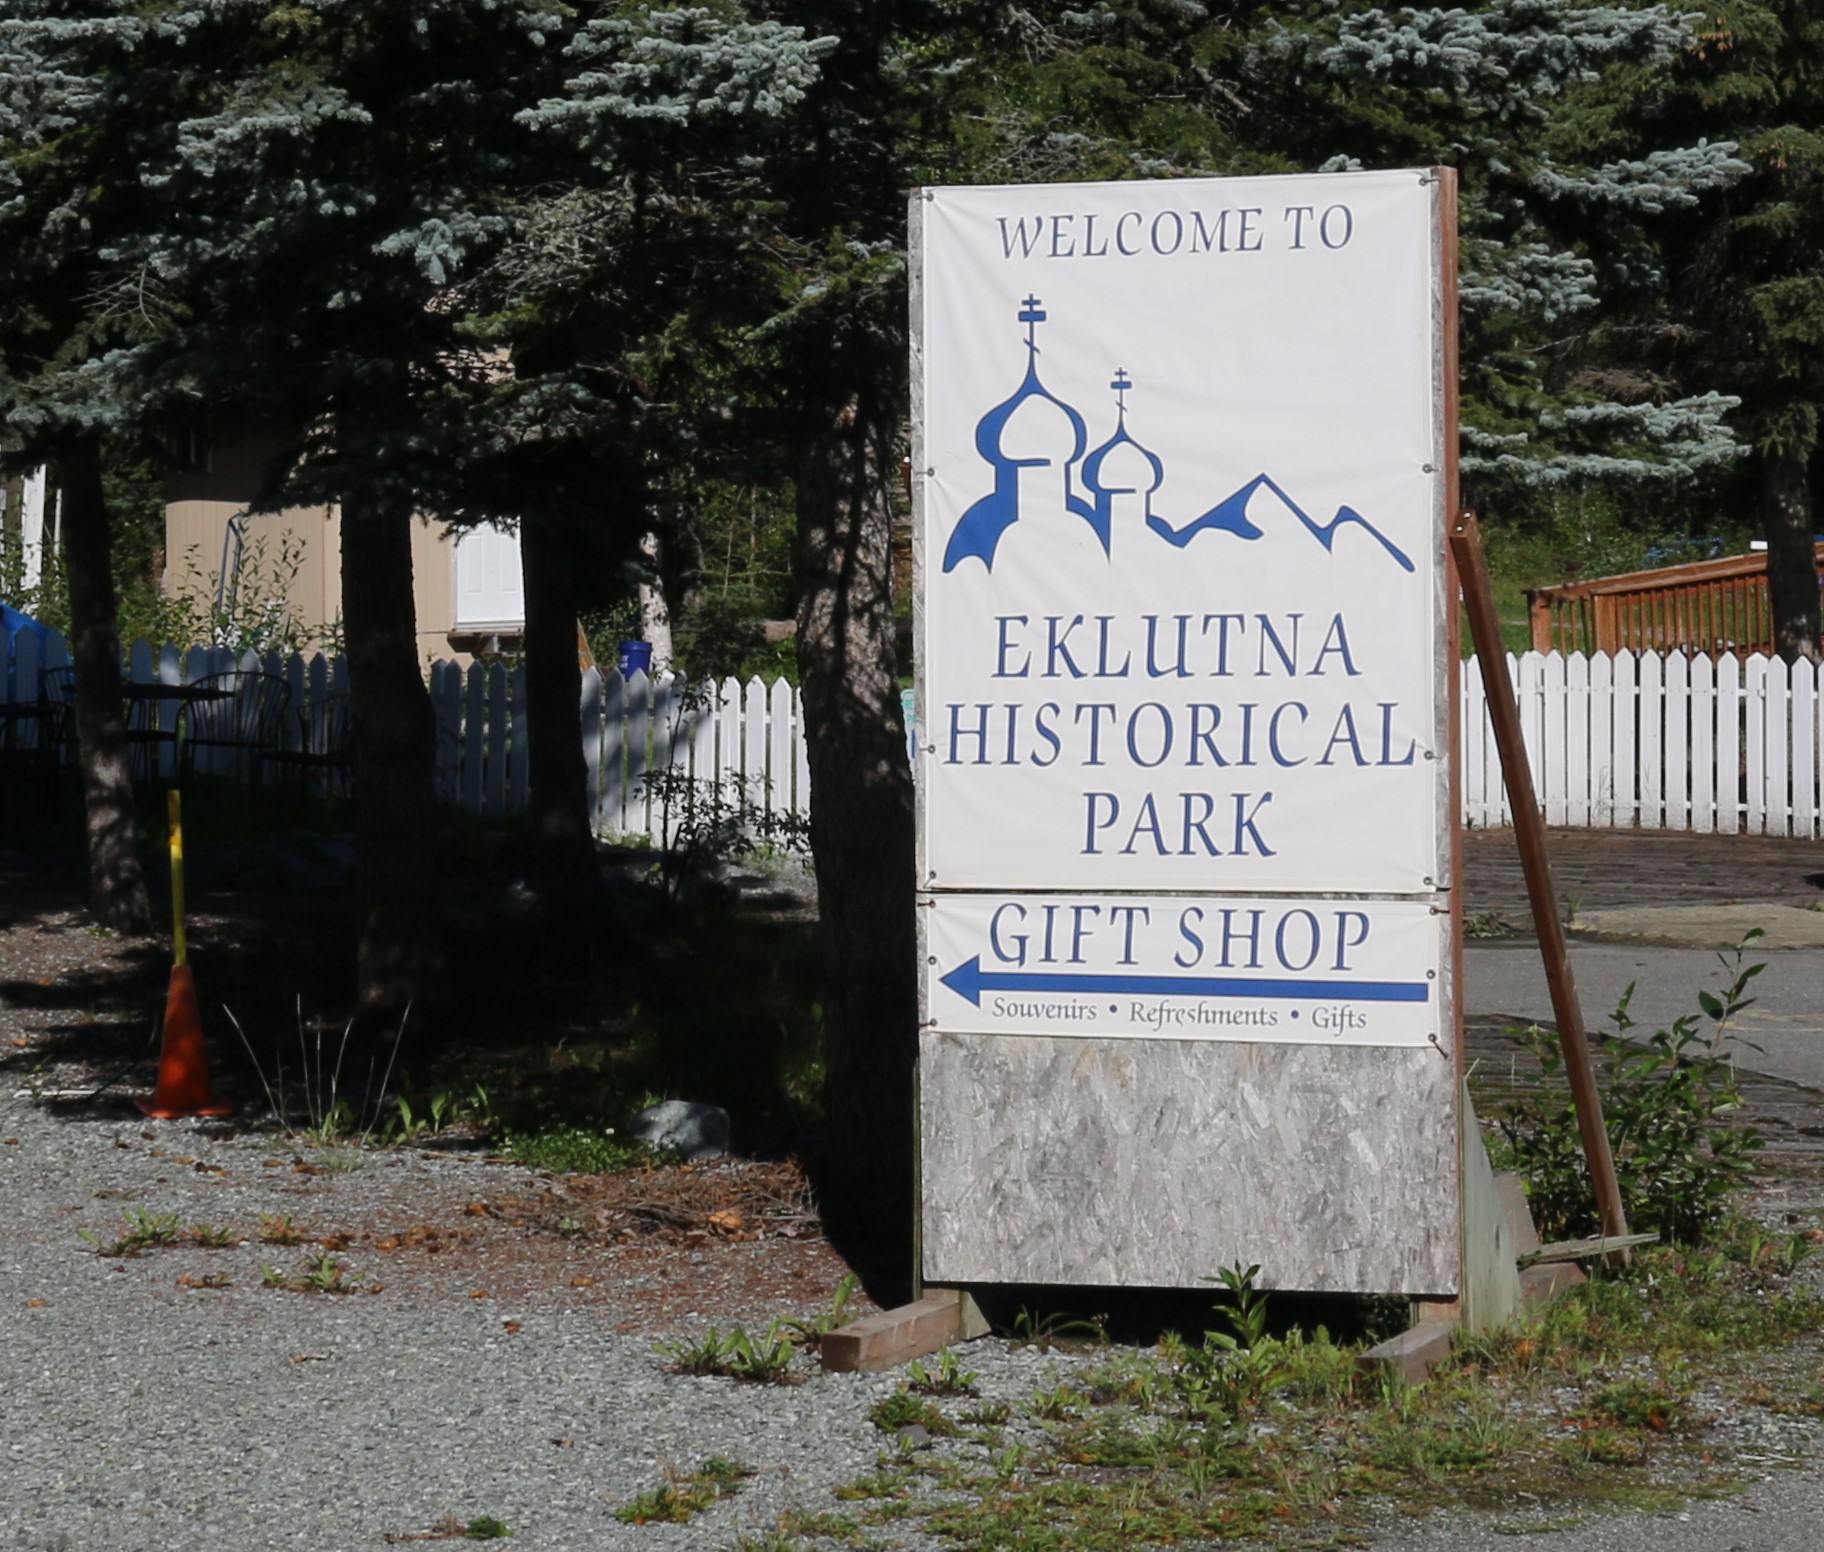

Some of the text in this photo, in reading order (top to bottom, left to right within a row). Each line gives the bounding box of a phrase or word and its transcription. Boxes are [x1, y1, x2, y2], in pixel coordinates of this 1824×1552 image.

[996, 204, 1354, 260] WELCOME TO
[991, 612, 1362, 680] EKLUTNA
[942, 700, 1417, 769] HISTORICAL
[1079, 791, 1278, 858] PARK
[989, 902, 1371, 972] GIFT SHOP
[992, 996, 1368, 1037] Souvenirs Refreshments Gifts
